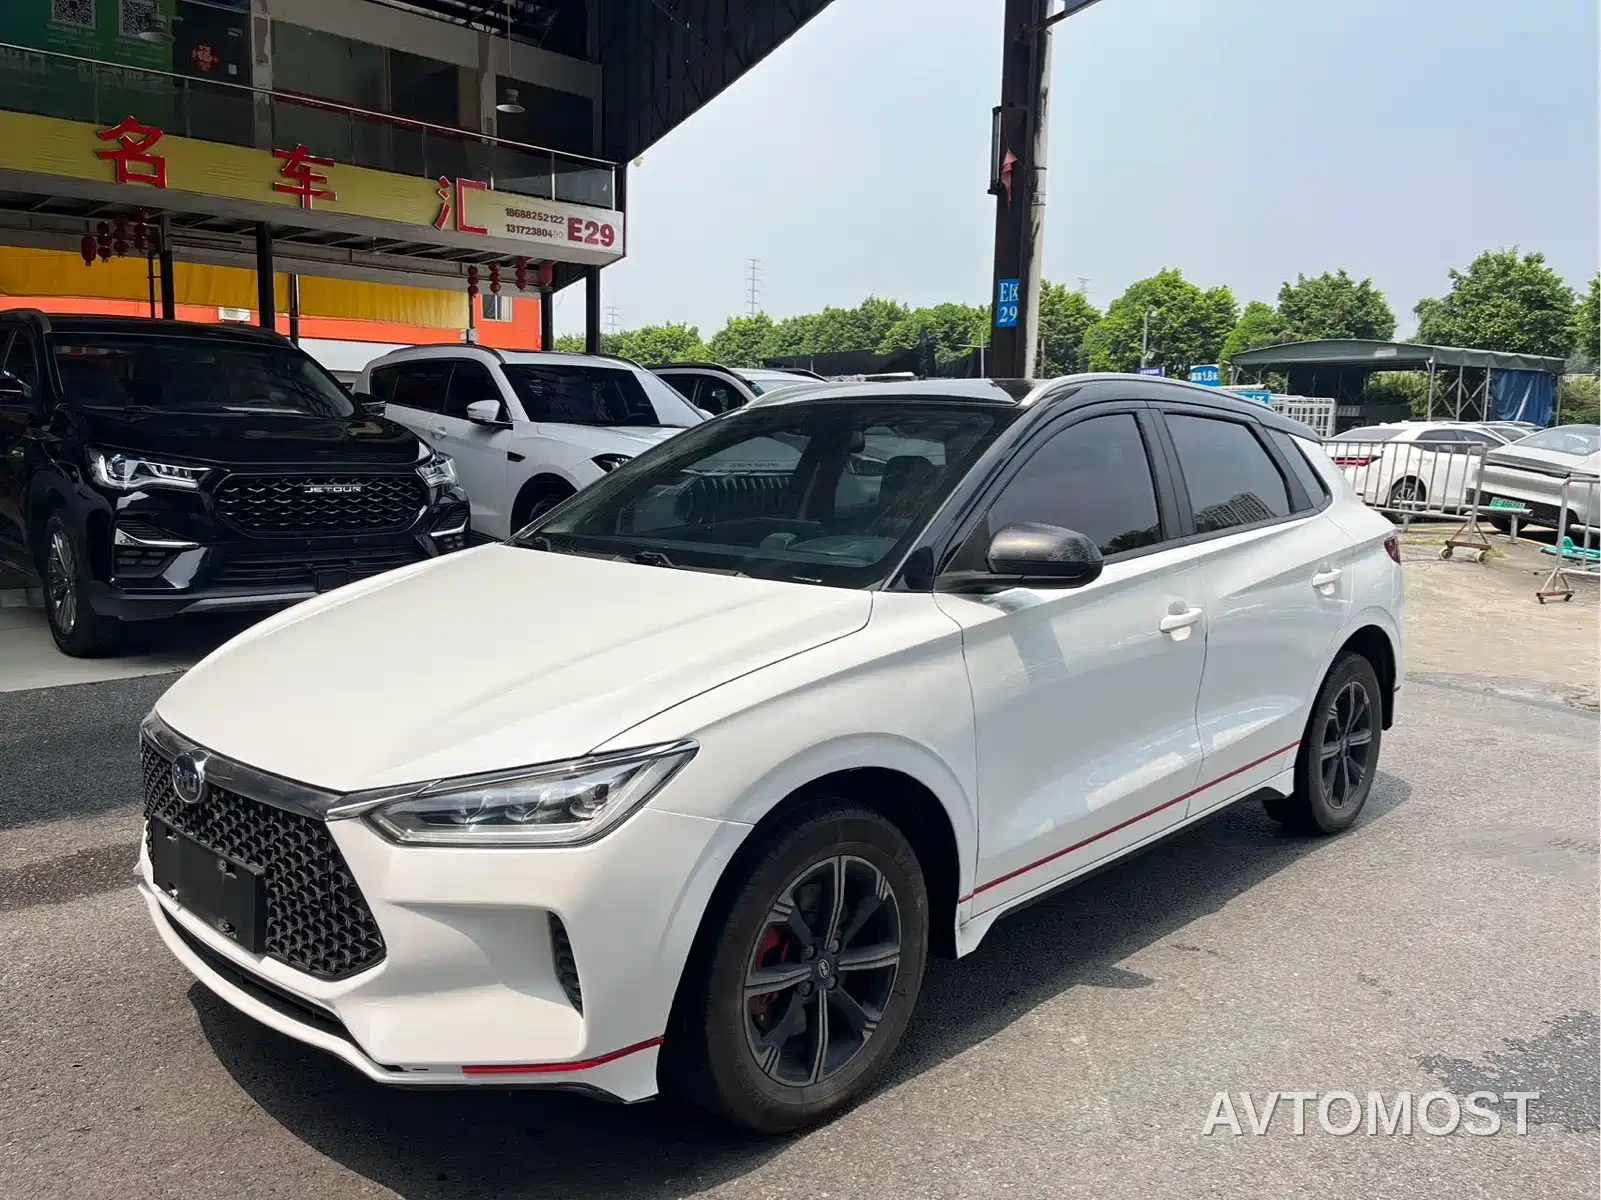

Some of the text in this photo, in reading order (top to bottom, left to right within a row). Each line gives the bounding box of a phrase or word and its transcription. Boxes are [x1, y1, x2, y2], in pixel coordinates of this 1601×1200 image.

[96, 115, 488, 236] 名车汇
[505, 207, 564, 225] 18688252122
[568, 217, 615, 247] E29
[999, 282, 1019, 302] E区
[999, 305, 1018, 323] 29
